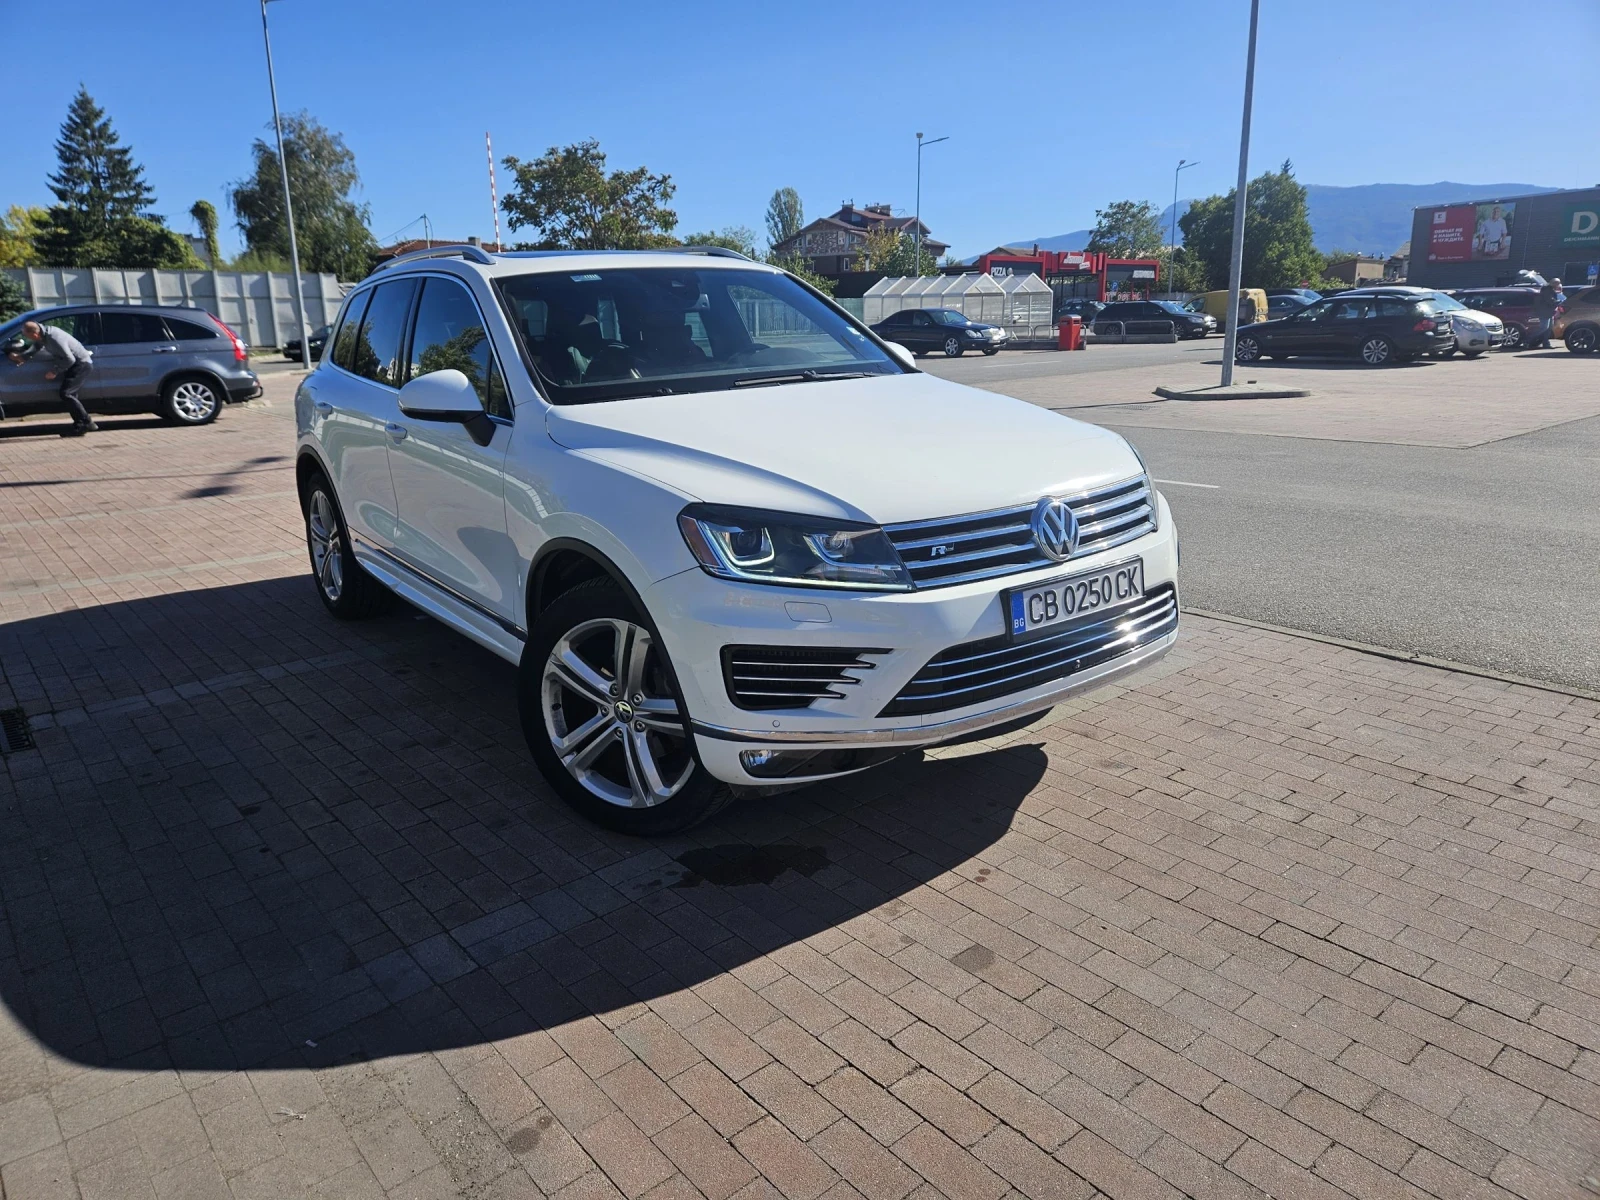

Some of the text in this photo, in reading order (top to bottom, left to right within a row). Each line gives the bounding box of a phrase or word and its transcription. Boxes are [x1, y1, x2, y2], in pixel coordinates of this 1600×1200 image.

[991, 266, 1007, 277] PIZZA
[1028, 565, 1140, 624] CB 0250 CK
[1014, 618, 1025, 629] BG
